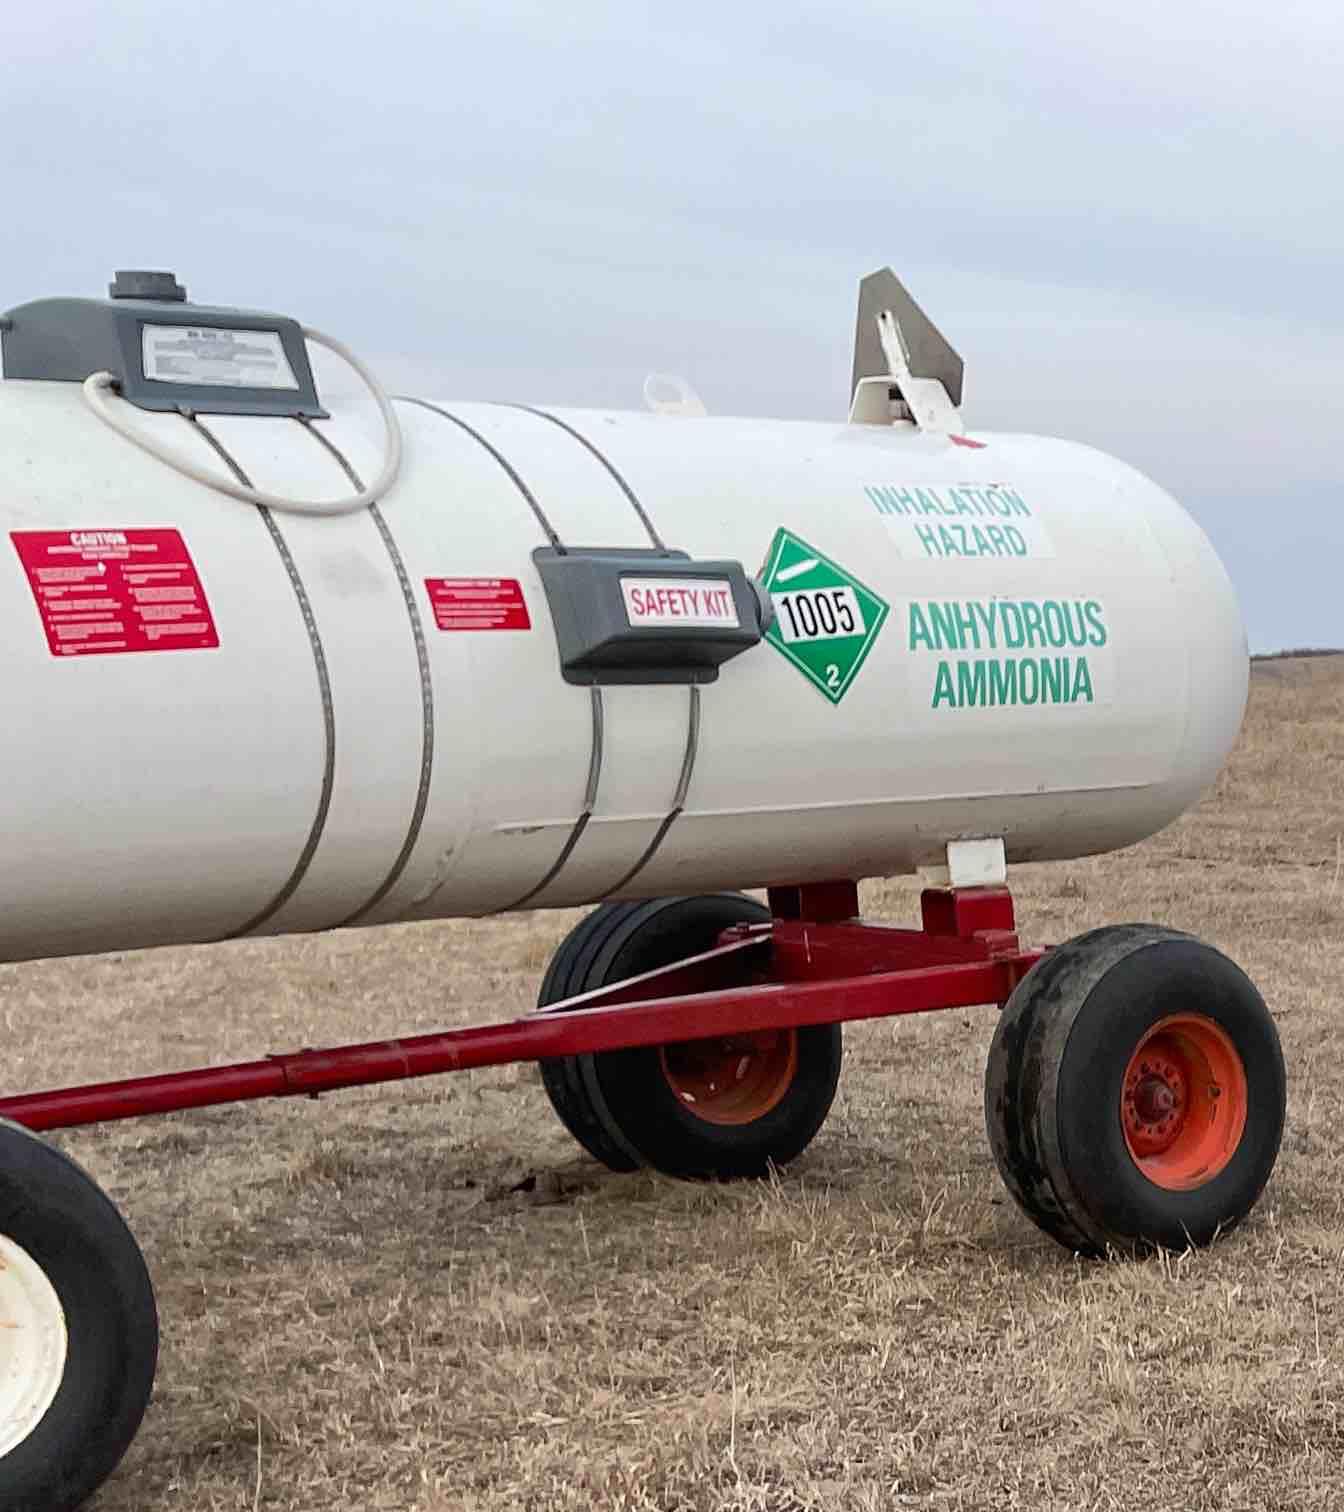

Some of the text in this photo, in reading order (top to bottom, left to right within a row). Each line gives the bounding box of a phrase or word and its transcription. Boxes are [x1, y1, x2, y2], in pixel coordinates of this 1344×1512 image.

[863, 486, 1032, 518] INHALATION
[913, 523, 1028, 557] HAZARD
[630, 587, 732, 618] SAFETY KIT
[780, 590, 856, 639] 1005
[907, 599, 1107, 652] ANHYDROUS
[825, 663, 841, 688] 2
[931, 656, 1094, 709] AMMONIA
